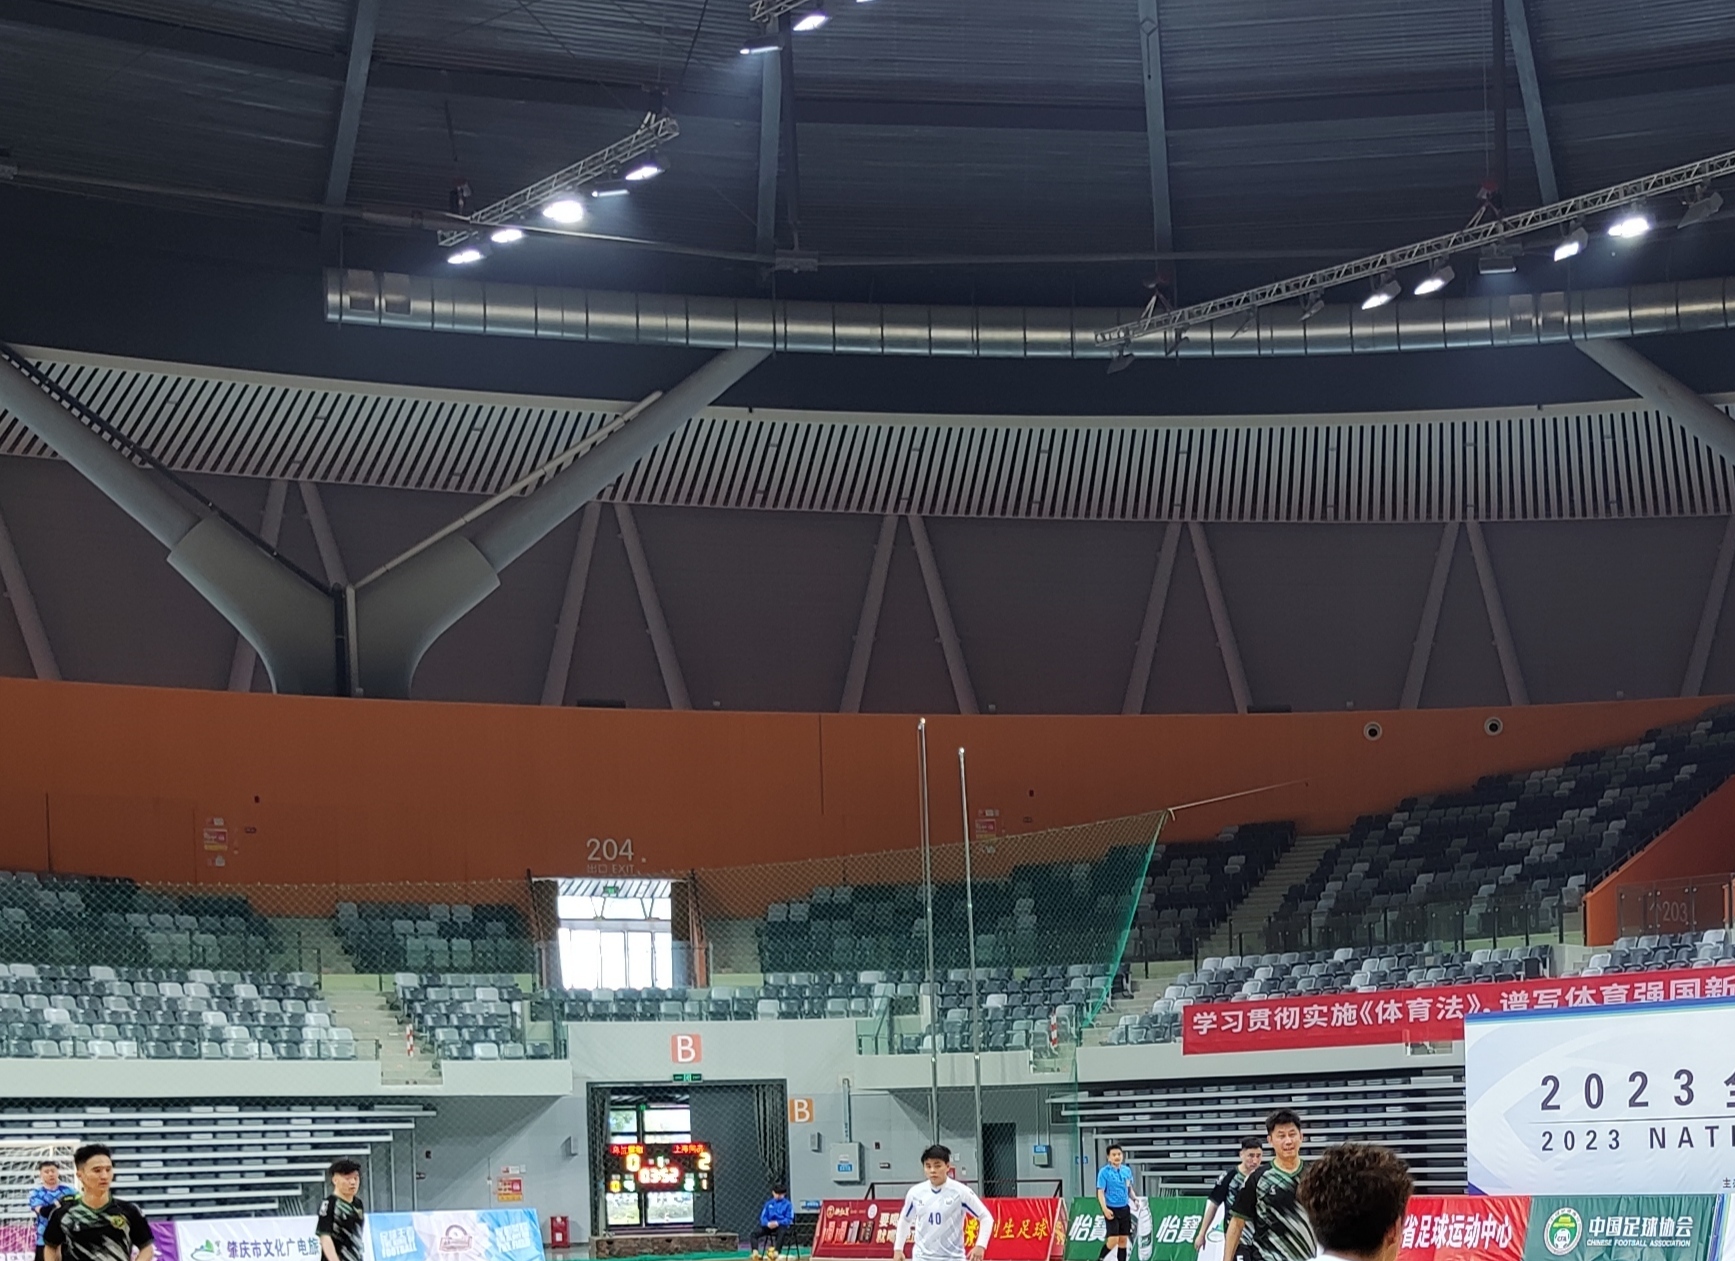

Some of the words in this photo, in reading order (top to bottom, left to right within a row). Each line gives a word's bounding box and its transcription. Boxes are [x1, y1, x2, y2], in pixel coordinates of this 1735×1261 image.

[586, 838, 634, 861] 204
[612, 864, 634, 873] EXIT
[677, 1035, 696, 1063] B
[793, 1099, 810, 1122] B
[1541, 1129, 1620, 1151] 2023
[698, 1152, 711, 1170] 2
[928, 1212, 941, 1225] 40
[1156, 1214, 1202, 1243] 怡寶
[1589, 1216, 1693, 1237] 中国足球协会
[1402, 1214, 1512, 1249] 省足球运动中心
[1614, 1239, 1648, 1247] FOOTBALL
[1649, 1239, 1691, 1247] ASSOCIATION
